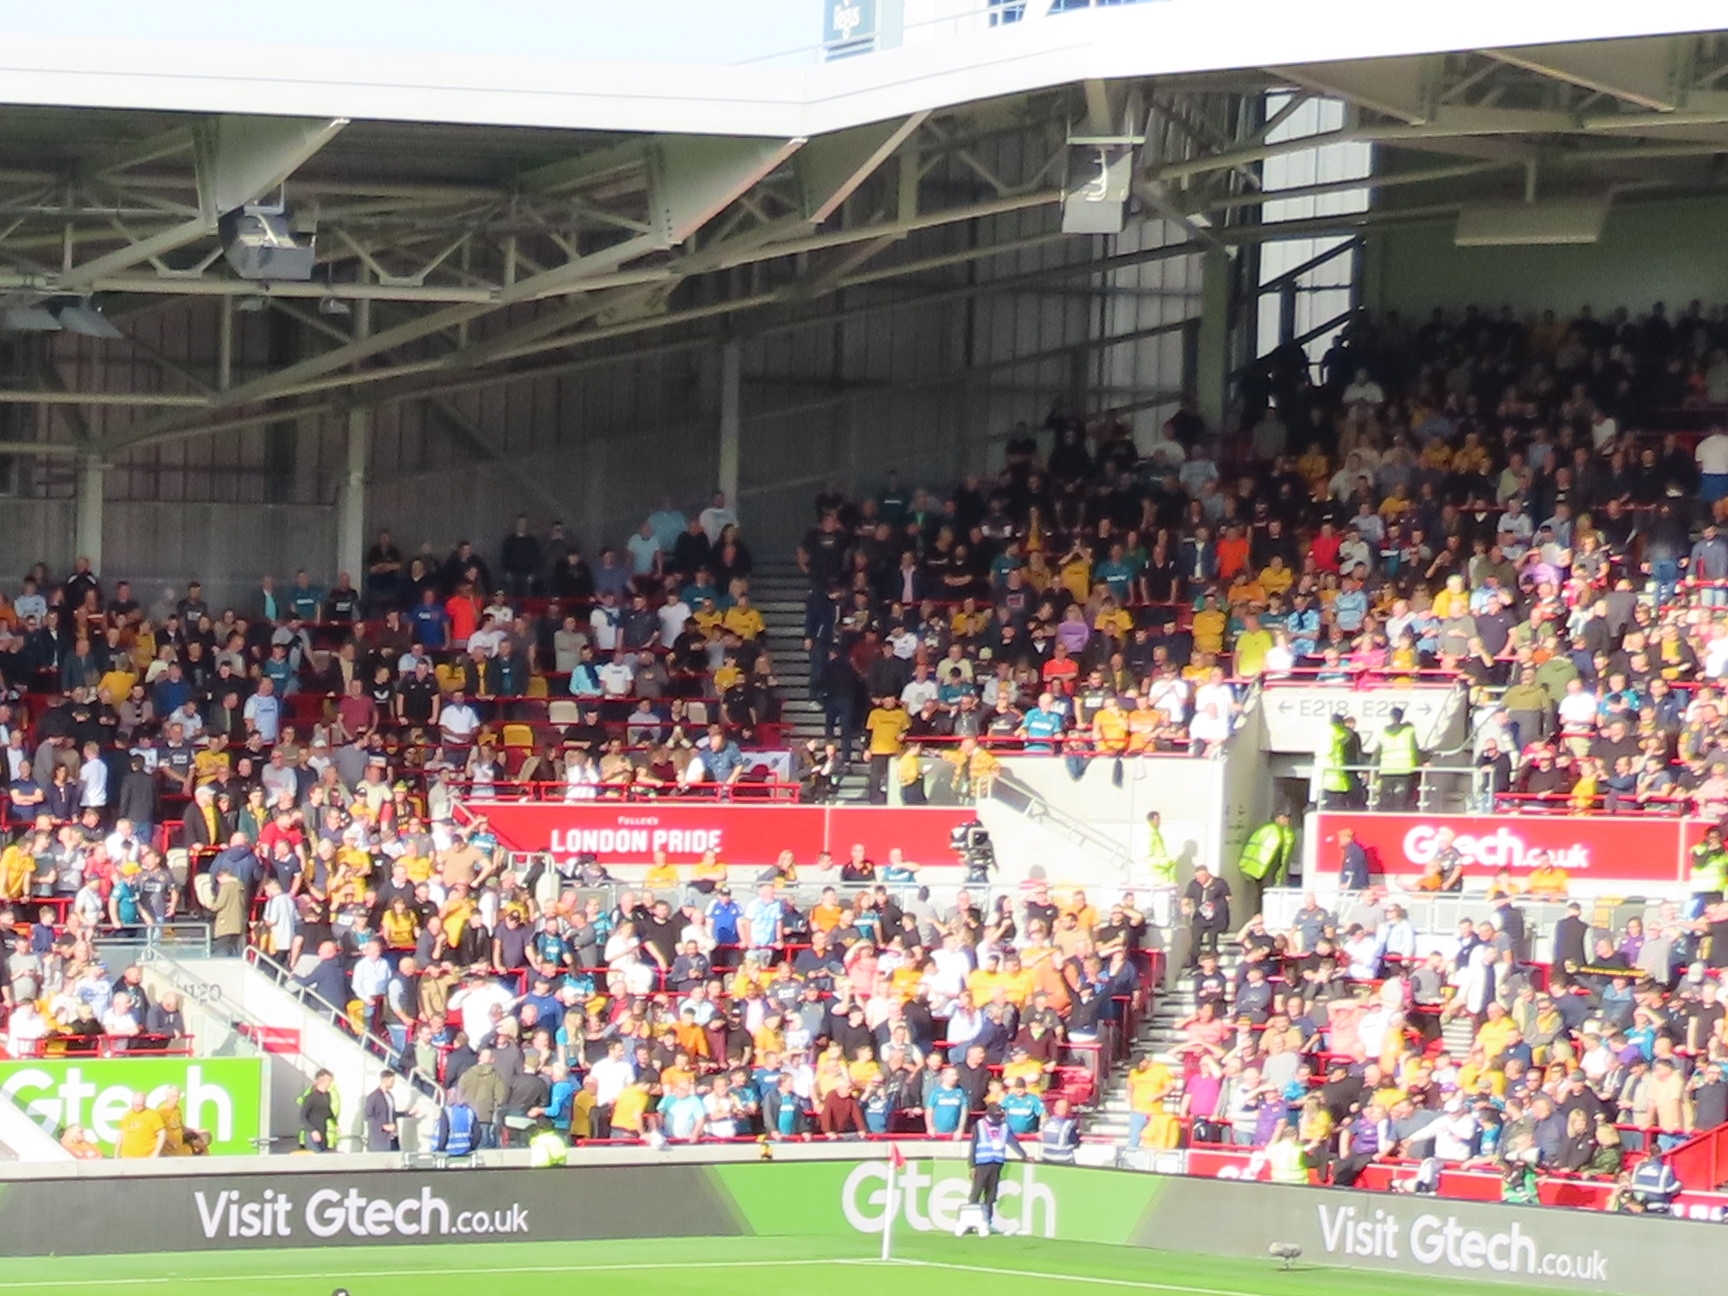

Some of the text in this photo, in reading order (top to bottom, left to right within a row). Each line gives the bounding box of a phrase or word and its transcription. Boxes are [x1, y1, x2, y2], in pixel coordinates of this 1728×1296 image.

[550, 828, 723, 854] LONDON PRIDE
[194, 1186, 529, 1239] Visit Gtech.co.uk
[1317, 1203, 1609, 1281] Visit Gtech.co.uk
